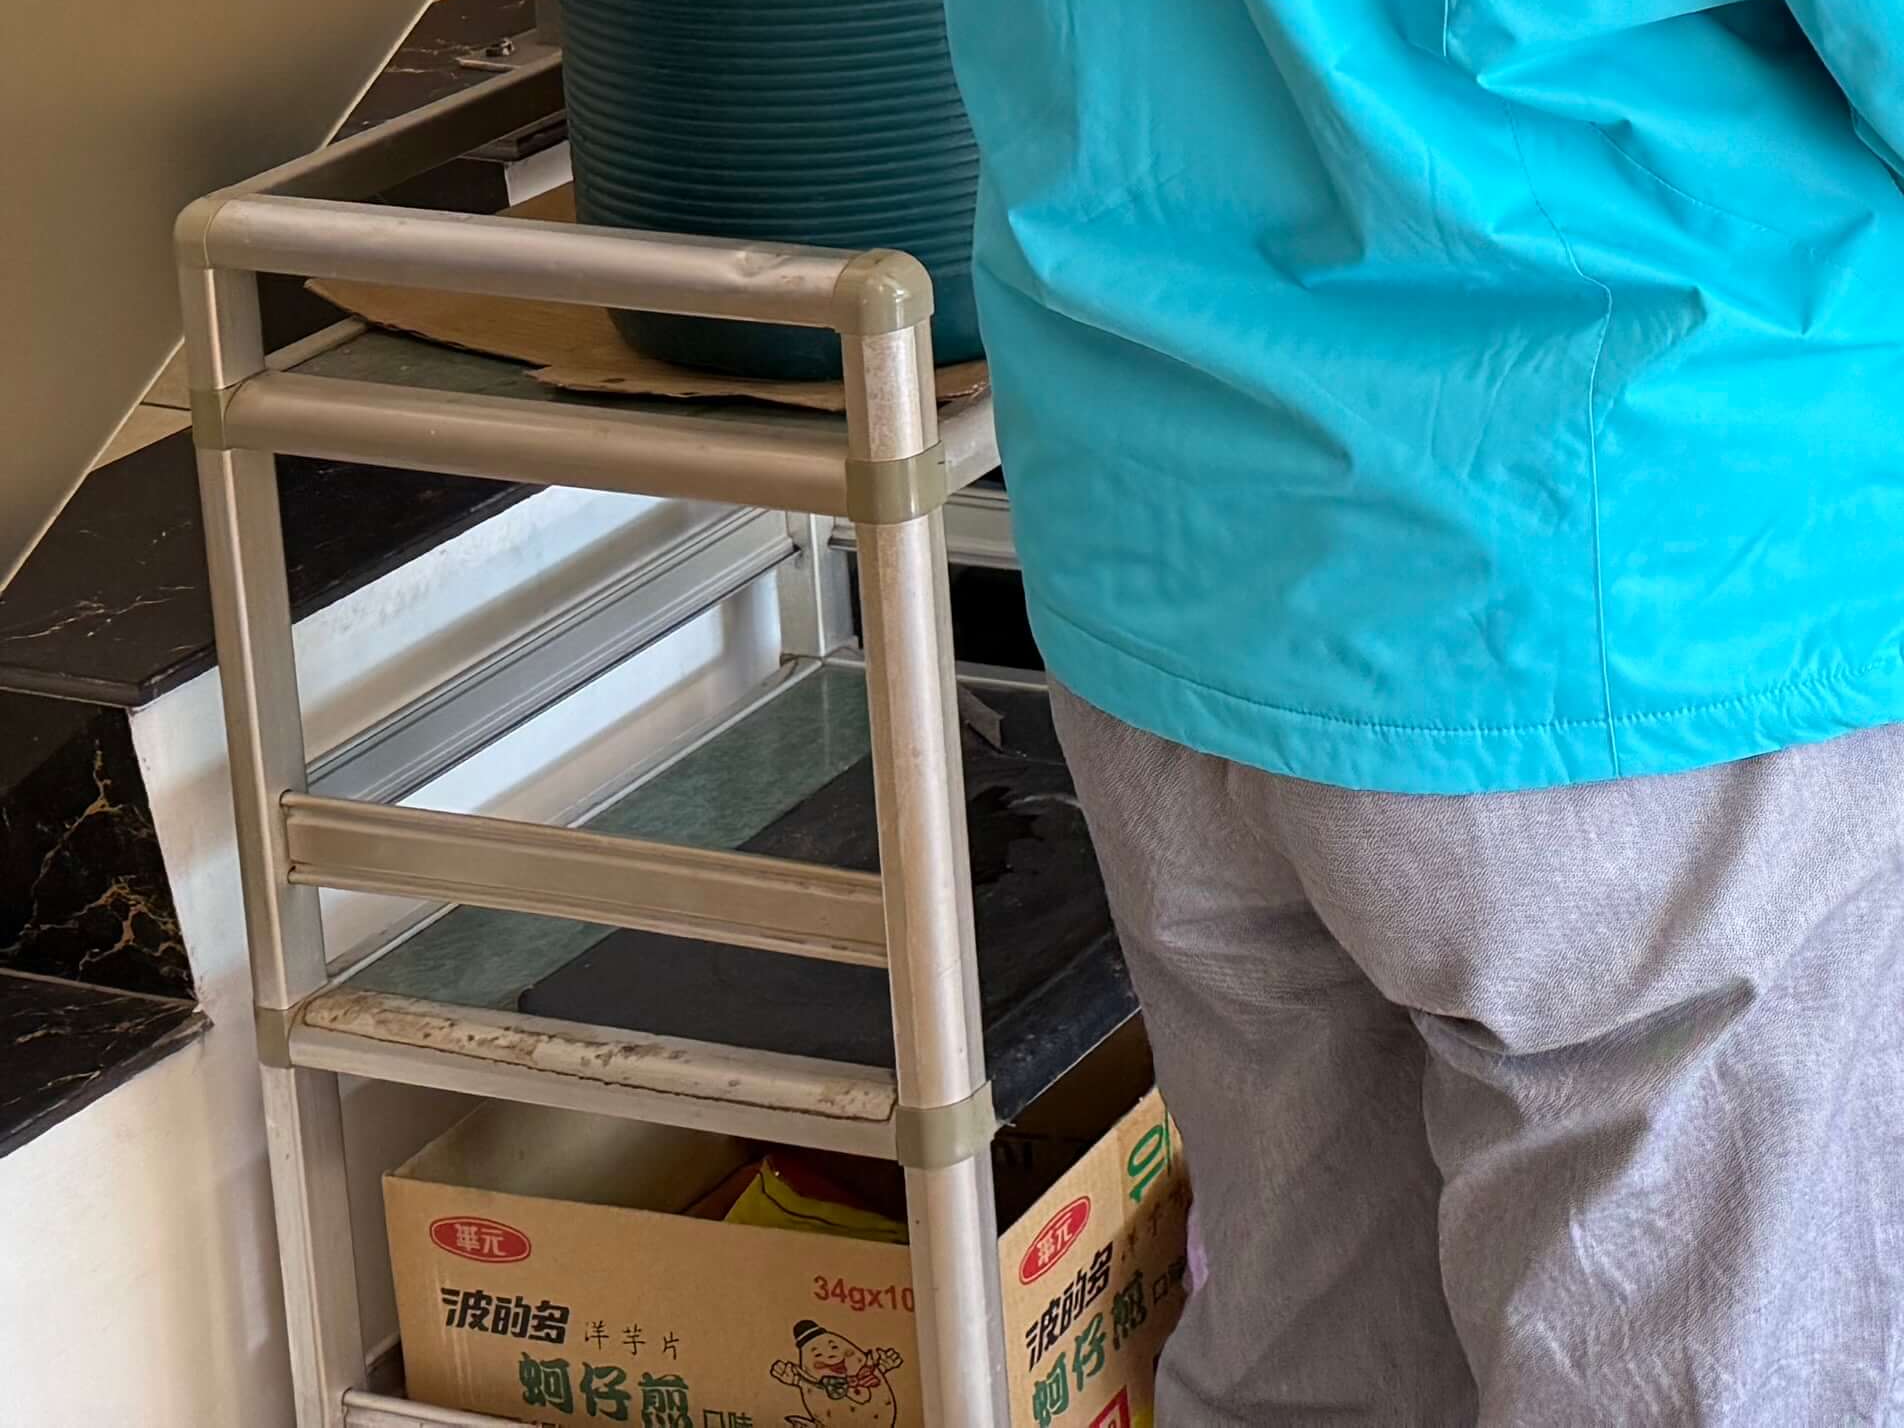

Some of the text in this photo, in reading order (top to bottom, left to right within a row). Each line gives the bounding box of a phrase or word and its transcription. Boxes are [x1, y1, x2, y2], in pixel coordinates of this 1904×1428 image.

[454, 1224, 508, 1258] 華元
[813, 1275, 915, 1312] 34gx10
[440, 1286, 682, 1361] 波的多 洋芋片
[517, 1351, 694, 1428] 蚵仔煎
